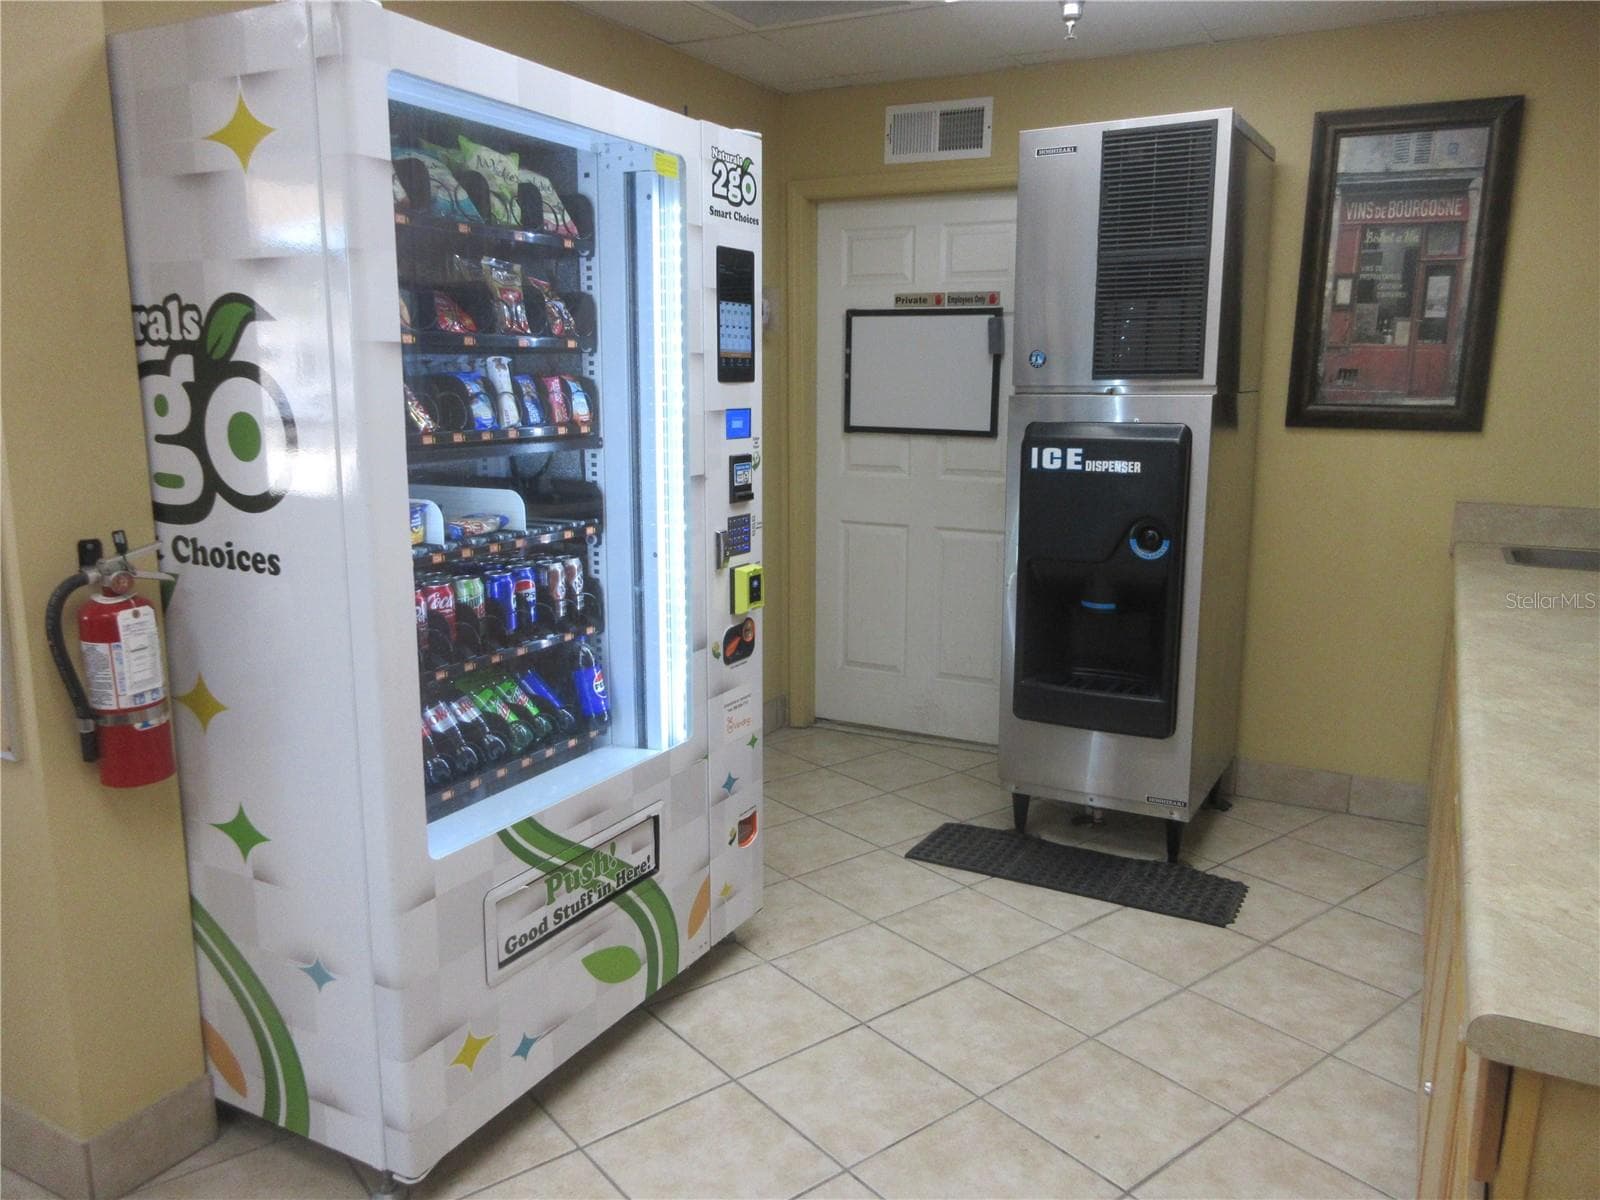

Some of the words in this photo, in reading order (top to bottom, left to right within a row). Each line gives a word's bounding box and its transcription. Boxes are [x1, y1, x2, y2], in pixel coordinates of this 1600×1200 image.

[712, 159, 757, 207] 2go
[709, 205, 732, 220] Smart
[733, 211, 759, 226] Choices
[1346, 201, 1375, 221] VINS
[1388, 199, 1463, 219] BOURGOGNE
[895, 296, 929, 305] Private
[1031, 447, 1083, 471] ICE
[1085, 460, 1141, 474] DISPENSER
[171, 535, 281, 576] Choices
[544, 841, 617, 906] Push!
[504, 917, 549, 955] Good
[553, 889, 594, 926] Stuff
[597, 881, 612, 901] in
[615, 854, 652, 889] Here!
